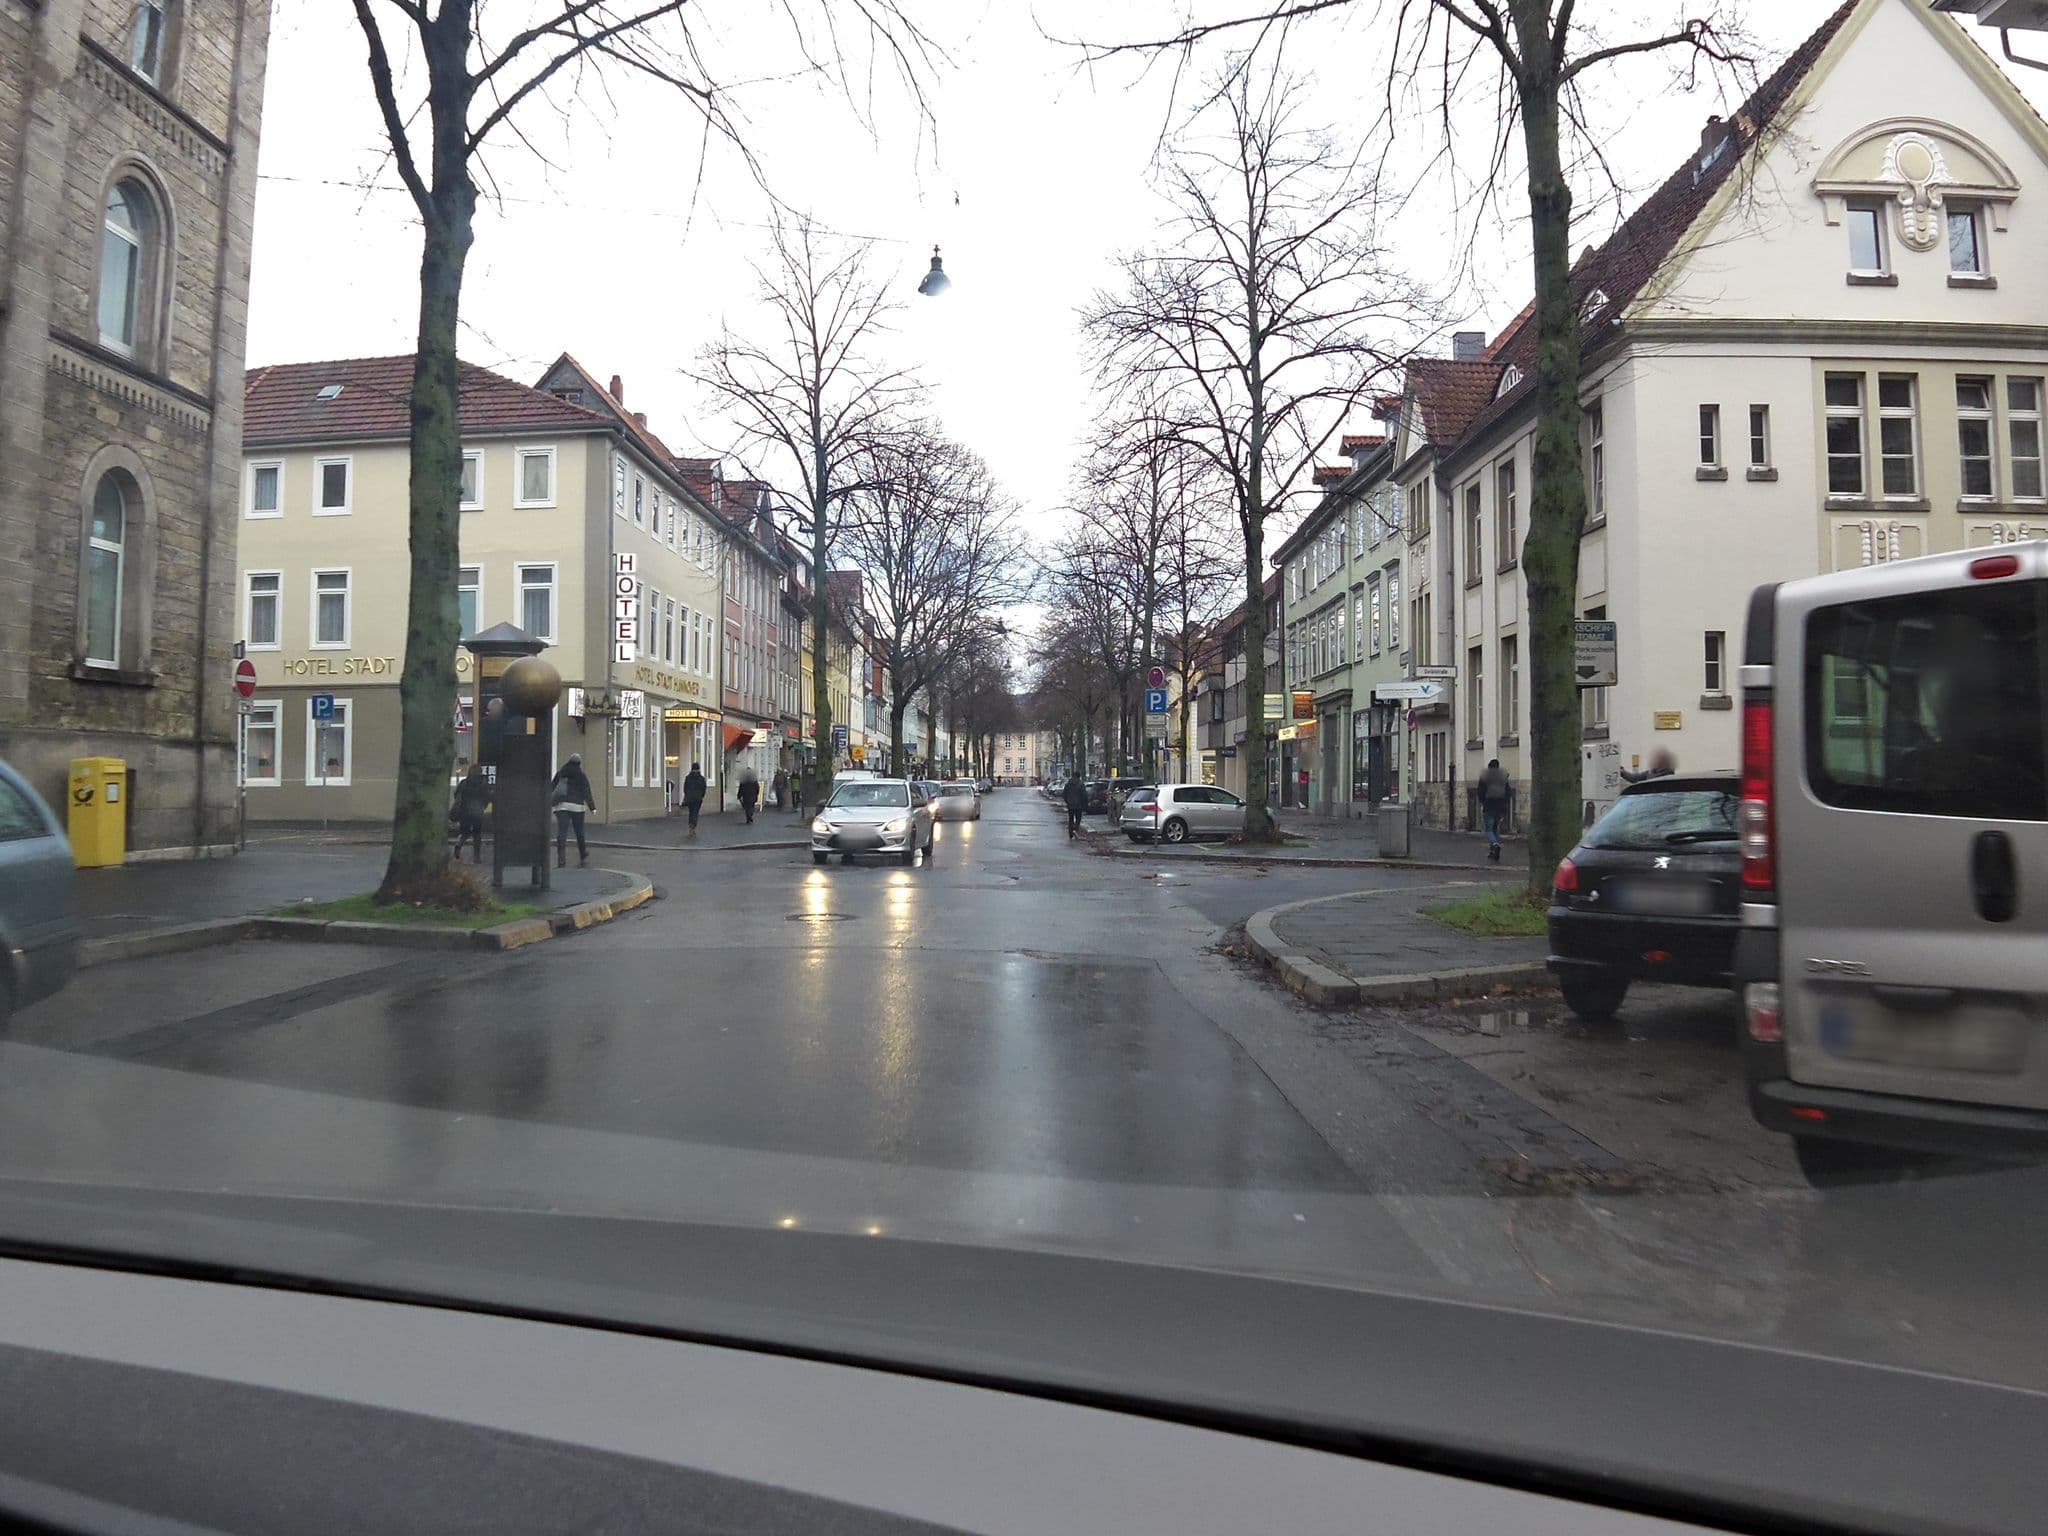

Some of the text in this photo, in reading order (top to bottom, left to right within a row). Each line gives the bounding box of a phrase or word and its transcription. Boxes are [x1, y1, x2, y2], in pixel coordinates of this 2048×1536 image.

[618, 555, 634, 661] HOTEL
[284, 656, 395, 676] HOTEL STADT
[316, 697, 329, 717] P
[1150, 692, 1162, 711] P
